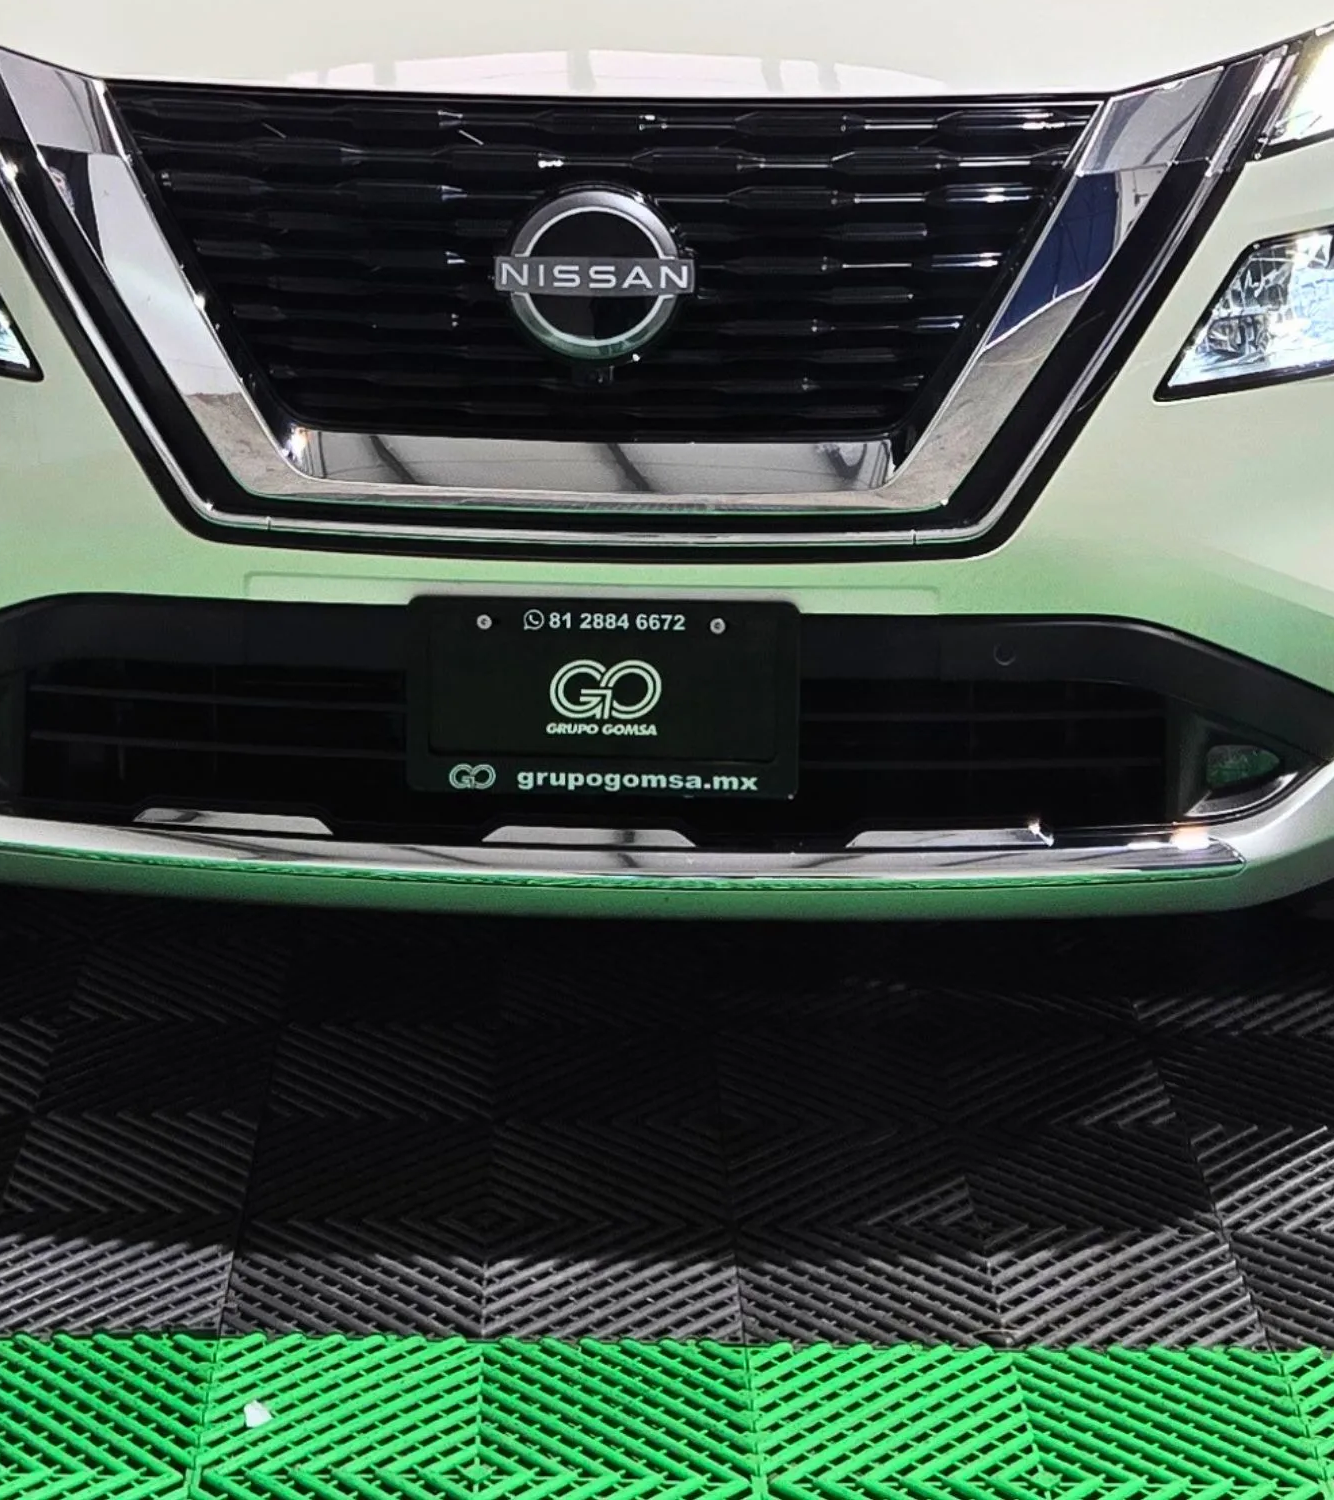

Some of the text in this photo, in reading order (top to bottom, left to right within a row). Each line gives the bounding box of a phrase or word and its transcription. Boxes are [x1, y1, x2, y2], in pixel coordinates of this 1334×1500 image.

[500, 262, 688, 289] NISSAN
[549, 612, 686, 632] 81 2884 6672
[546, 722, 658, 736] GRUPO GOMSA
[517, 769, 759, 792] grupogomsa.mx
